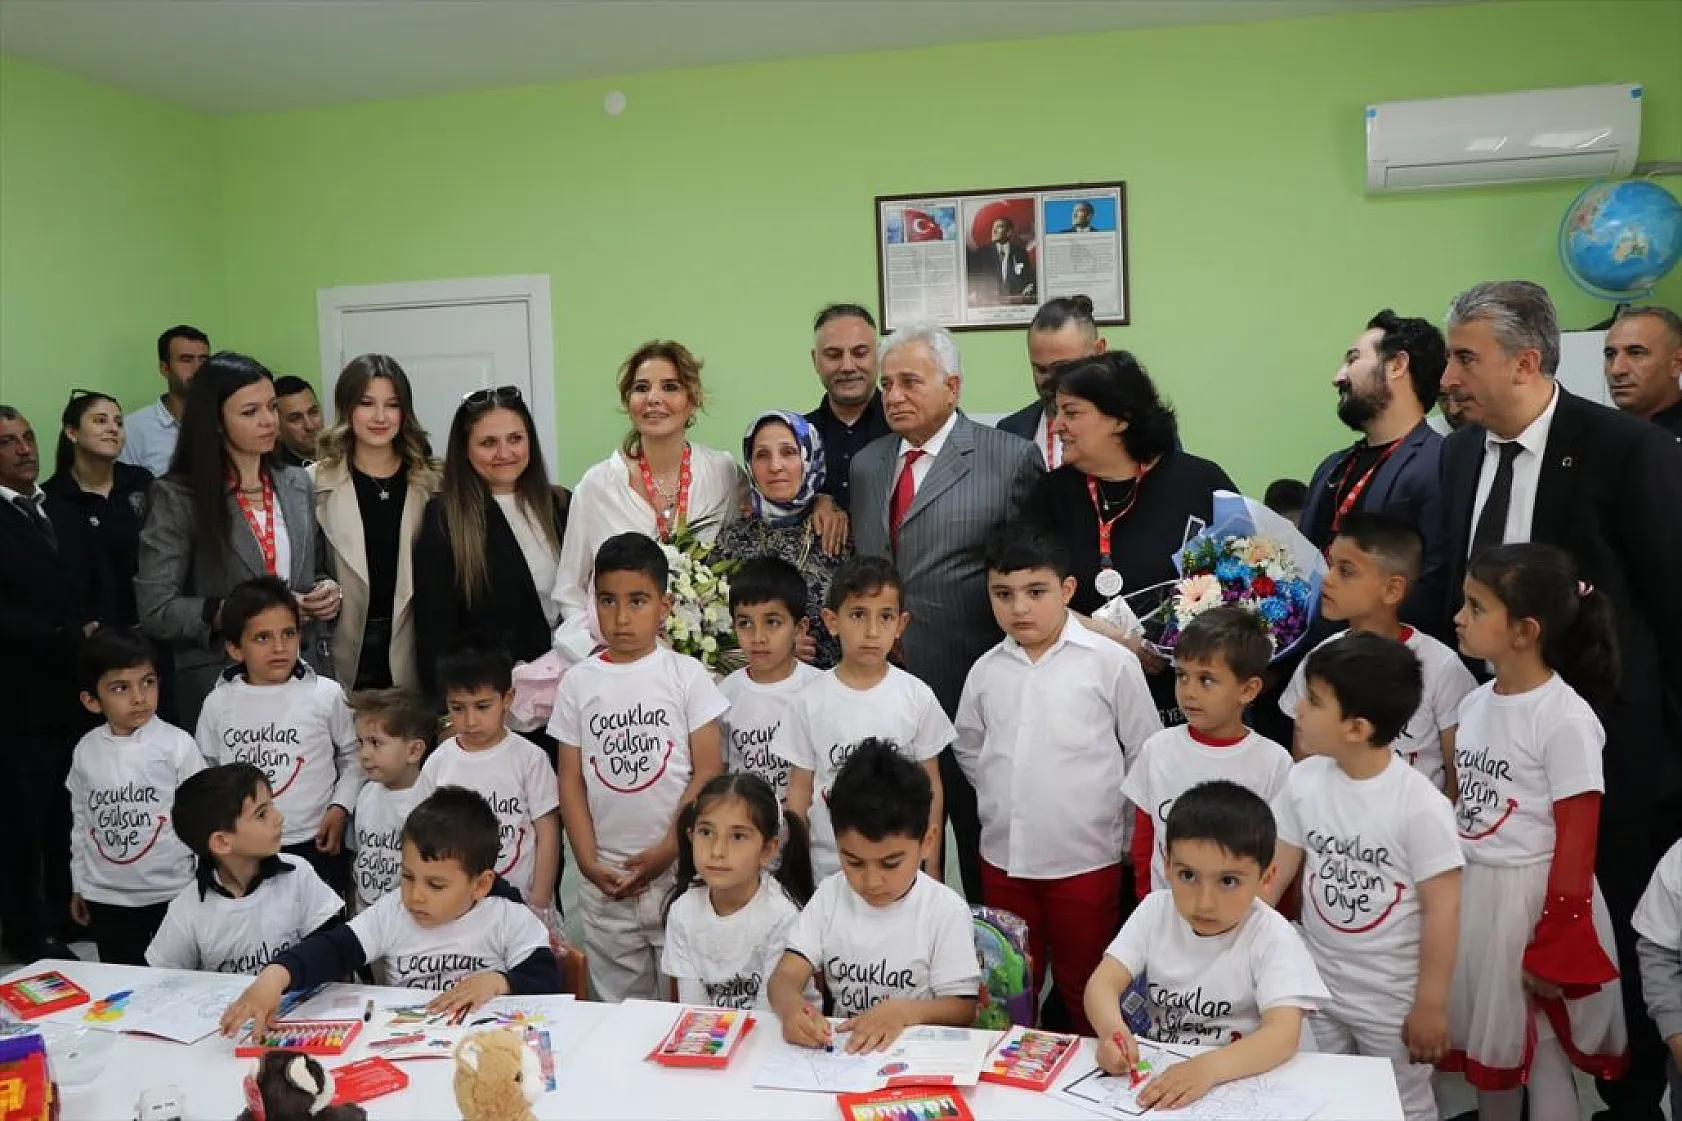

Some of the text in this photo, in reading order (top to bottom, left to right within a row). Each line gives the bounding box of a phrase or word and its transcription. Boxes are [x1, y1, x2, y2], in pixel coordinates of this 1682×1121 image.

[603, 729, 660, 755] Gülsün
[611, 755, 650, 785] Diye
[99, 805, 152, 830] Gülsün
[106, 829, 140, 859] Diye
[1320, 858, 1386, 893] Gülsün
[1325, 884, 1372, 924] Diye
